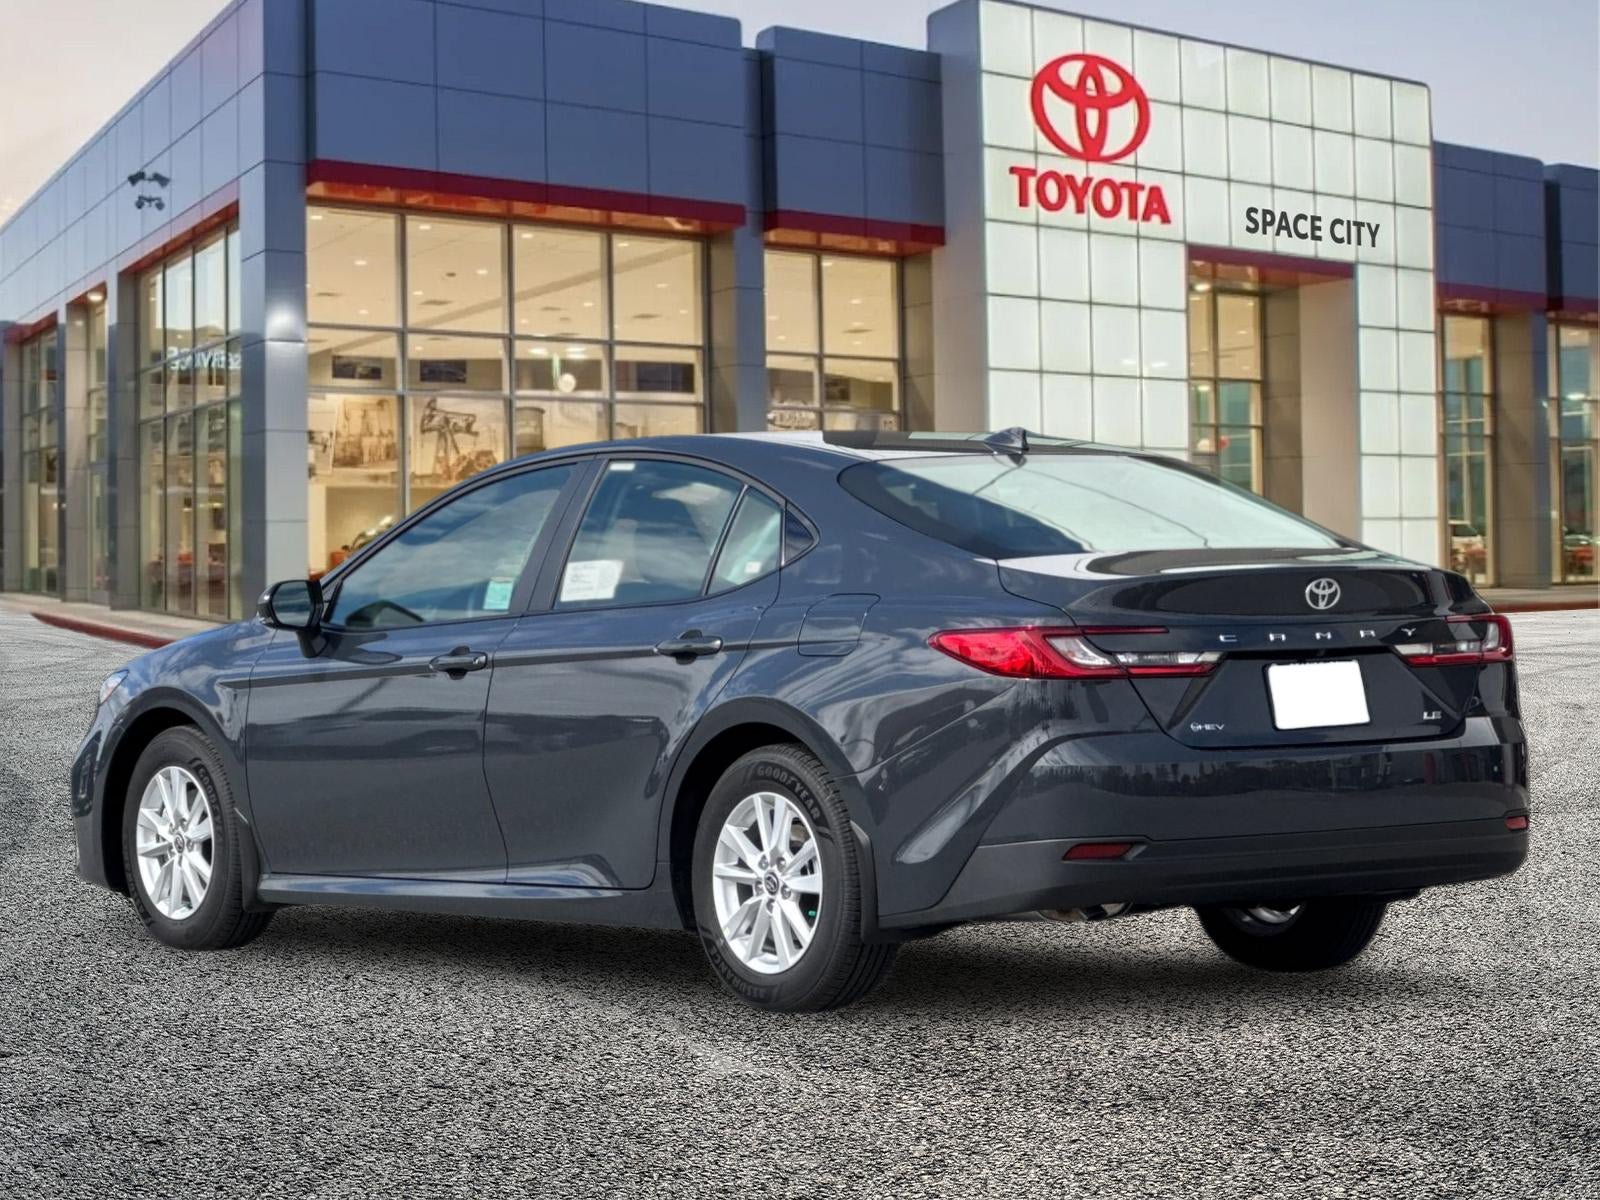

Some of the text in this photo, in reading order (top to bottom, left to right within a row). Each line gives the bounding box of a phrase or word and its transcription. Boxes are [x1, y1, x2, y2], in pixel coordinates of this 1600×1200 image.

[1009, 166, 1172, 225] TOYOTA
[1245, 206, 1381, 248] SPACE CITY
[1219, 628, 1417, 642] CAMRY
[1423, 711, 1441, 720] LE
[757, 766, 821, 819] GOODYEAR
